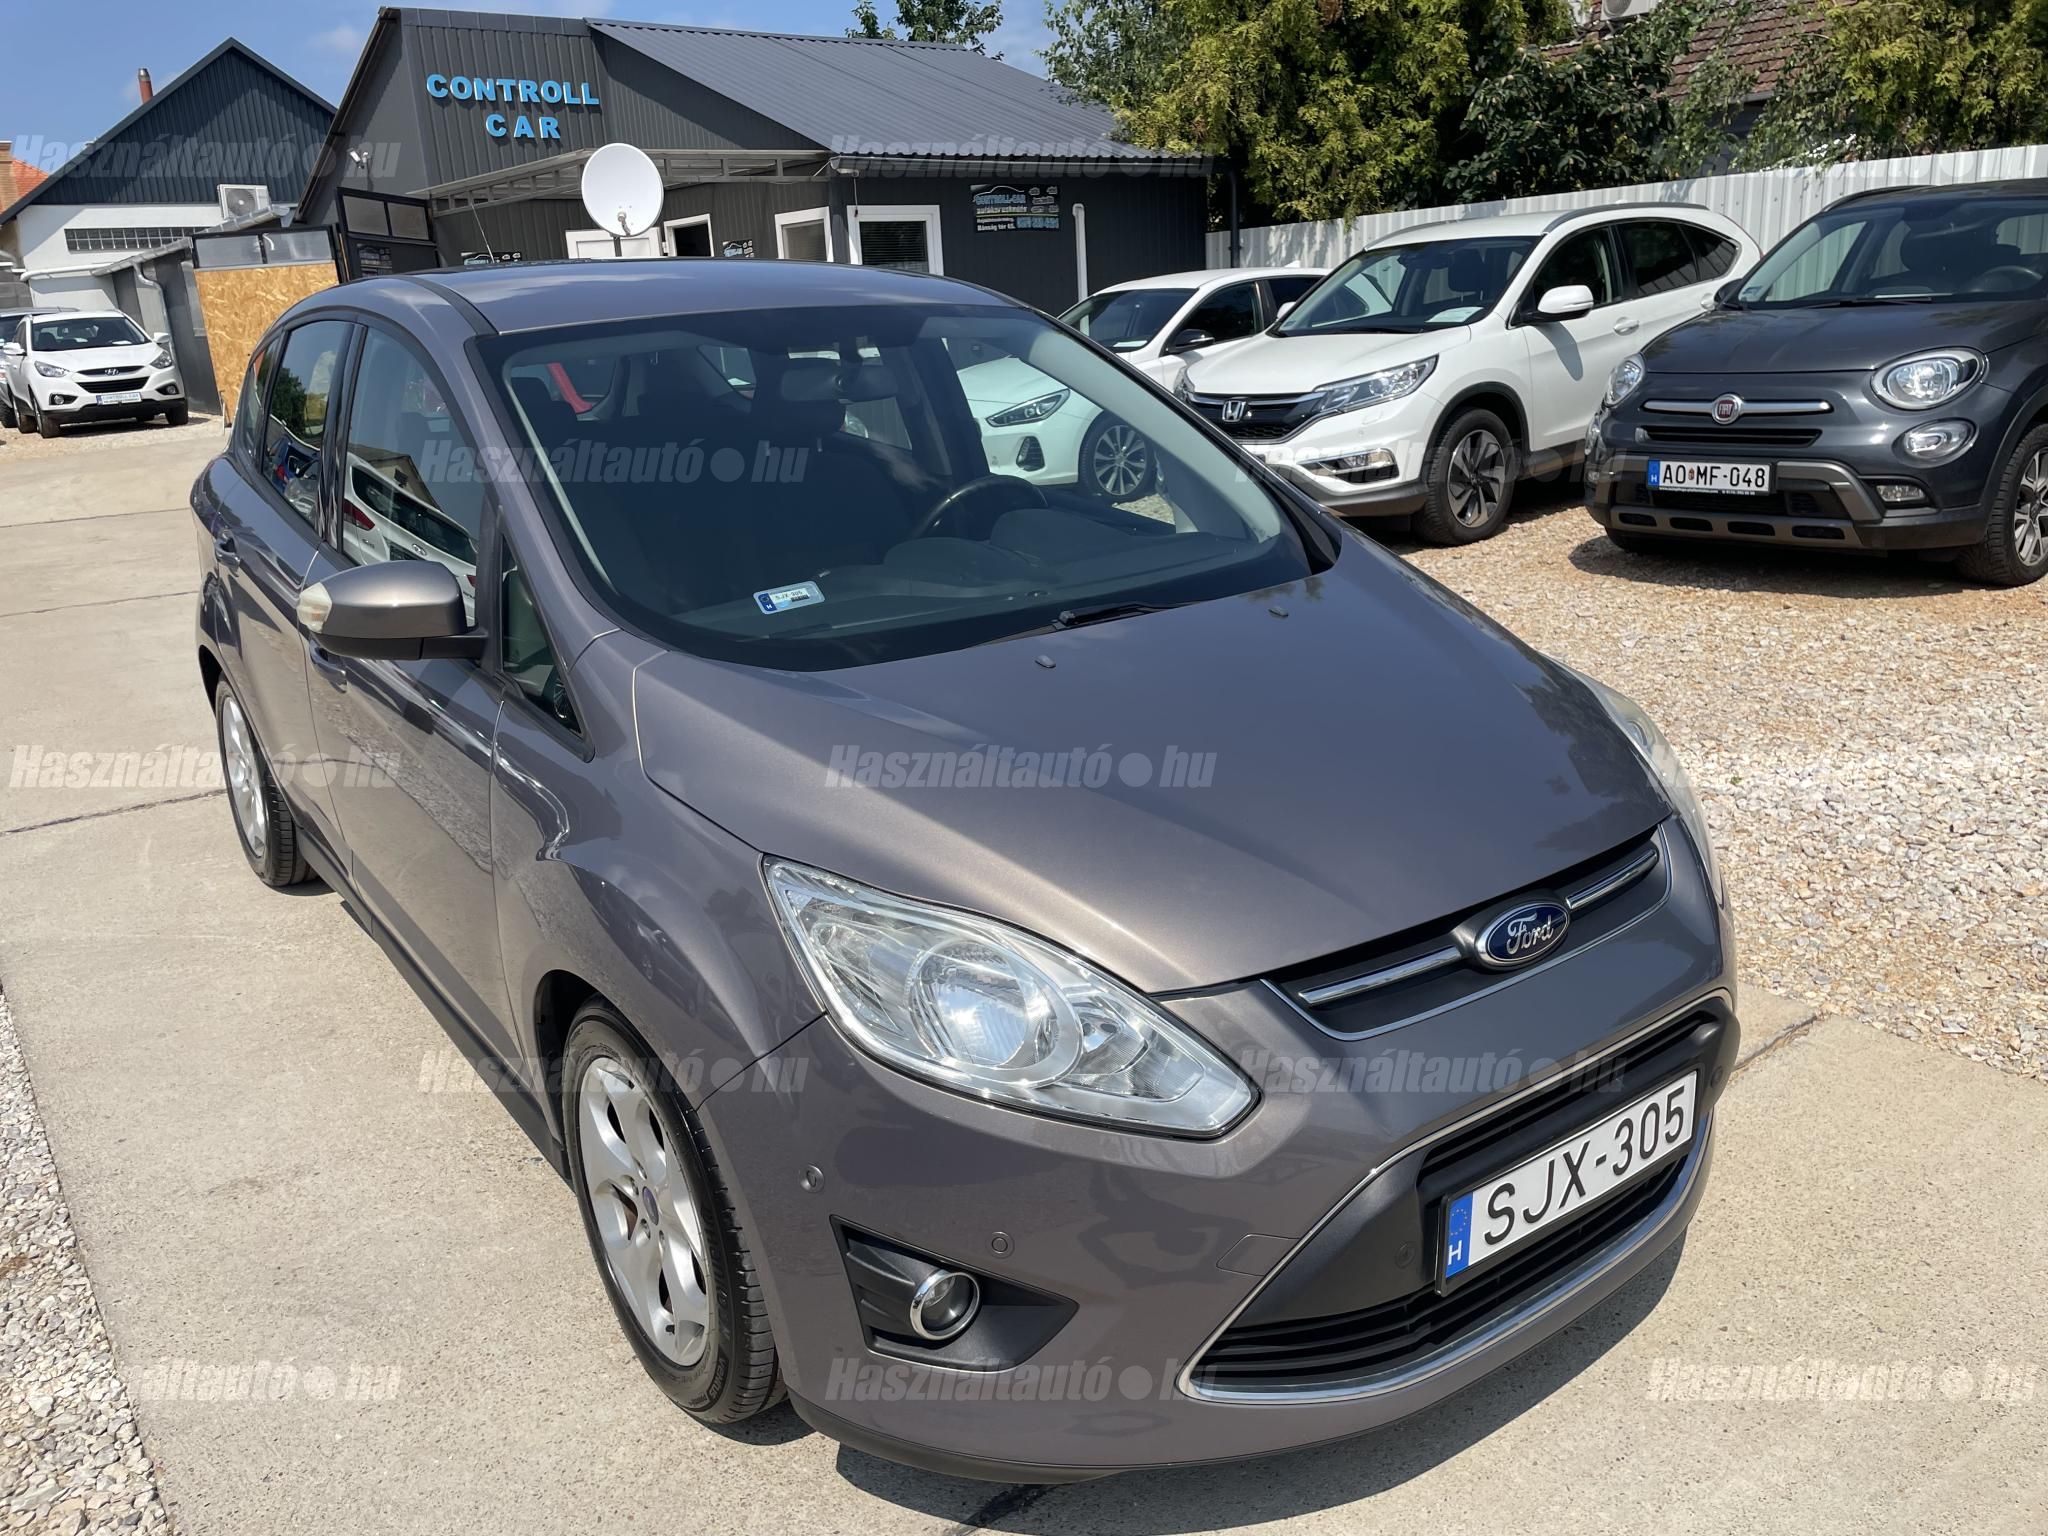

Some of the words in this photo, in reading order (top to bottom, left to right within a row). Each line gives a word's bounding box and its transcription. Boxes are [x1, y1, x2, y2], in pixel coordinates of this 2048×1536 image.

[426, 73, 600, 105] CONTROLL
[485, 113, 561, 139] CAR
[1719, 403, 1734, 415] FIAT
[1650, 474, 1658, 482] H
[1696, 465, 1766, 488] MF-048
[1506, 912, 1555, 956] Ford
[1483, 1084, 1686, 1246] SJX-305
[1447, 1244, 1462, 1266] H
